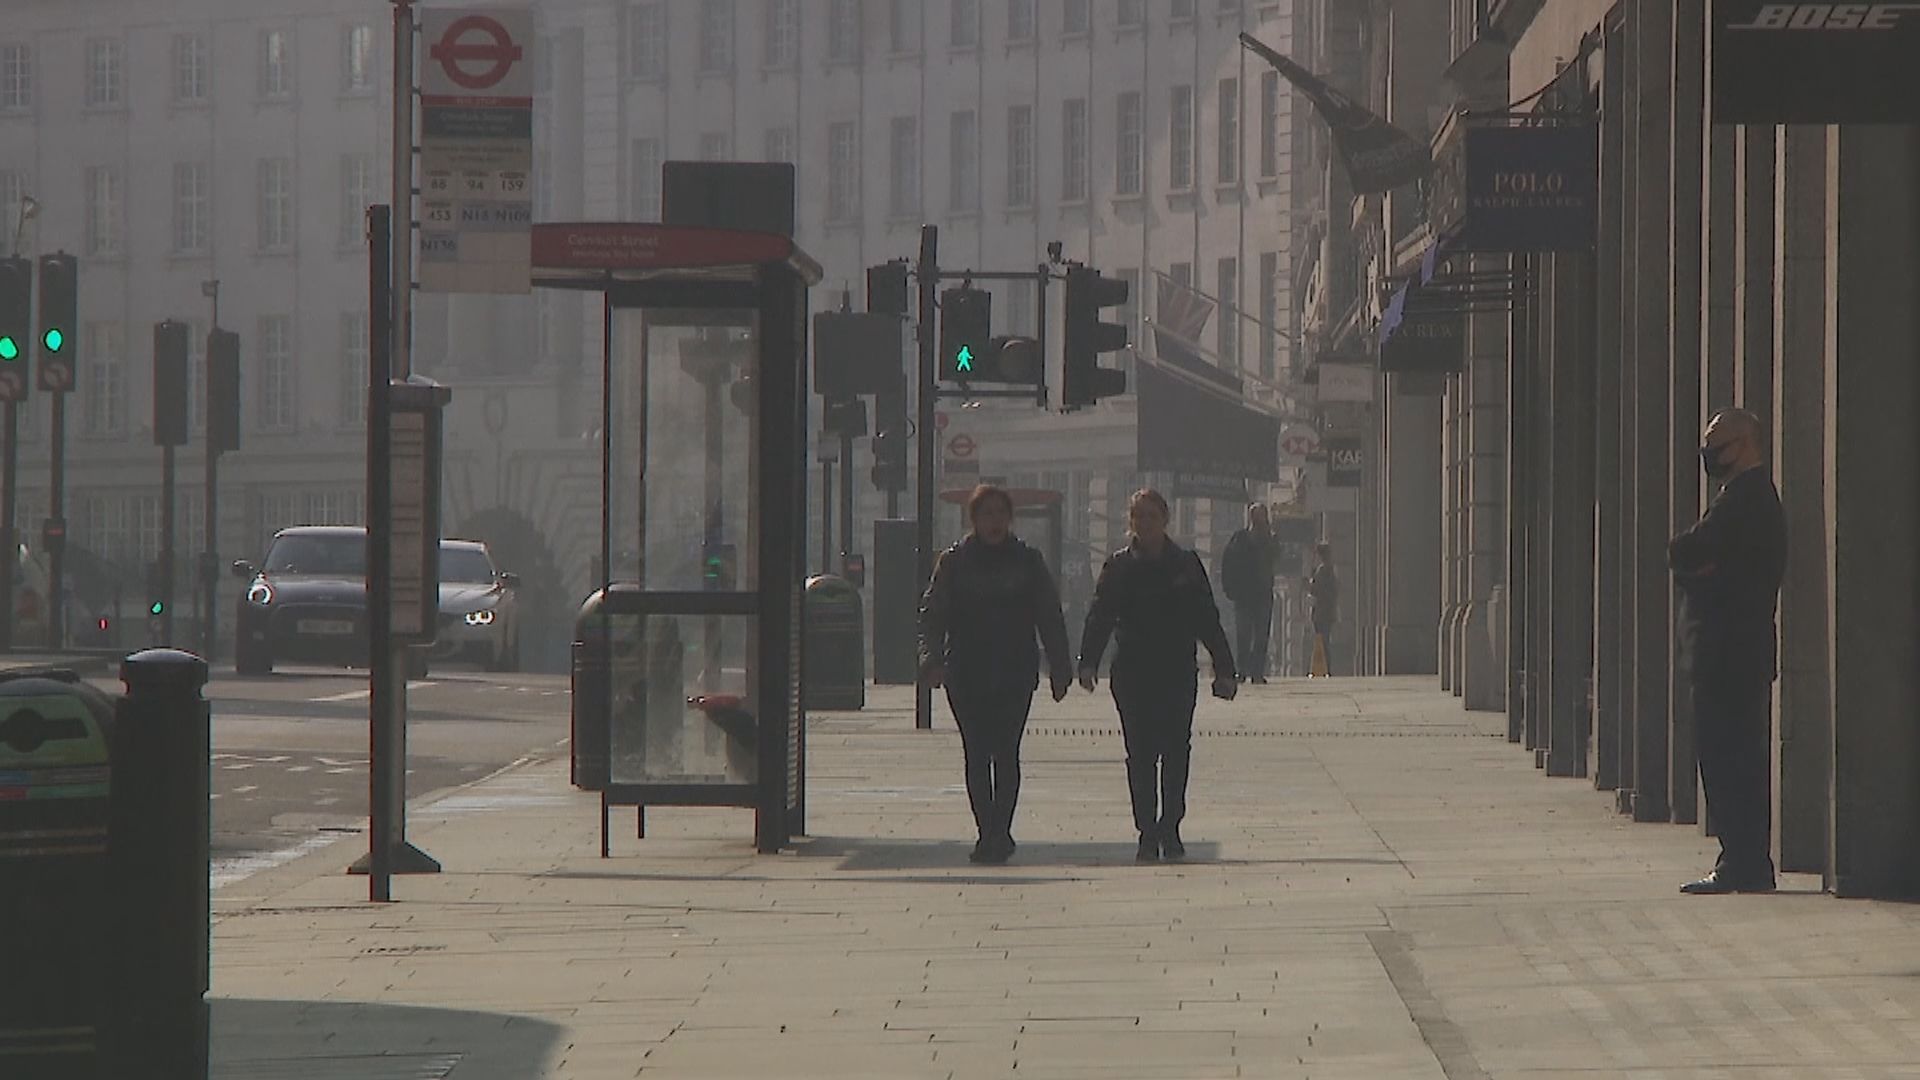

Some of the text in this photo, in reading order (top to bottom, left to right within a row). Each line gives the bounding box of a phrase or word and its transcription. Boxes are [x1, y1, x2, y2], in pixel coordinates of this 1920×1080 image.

[1740, 4, 1905, 29] BOSE
[468, 179, 485, 191] 94
[501, 180, 525, 192] 159
[1493, 172, 1563, 193] POLO
[1472, 196, 1520, 208] RALPH
[621, 234, 659, 247] Street
